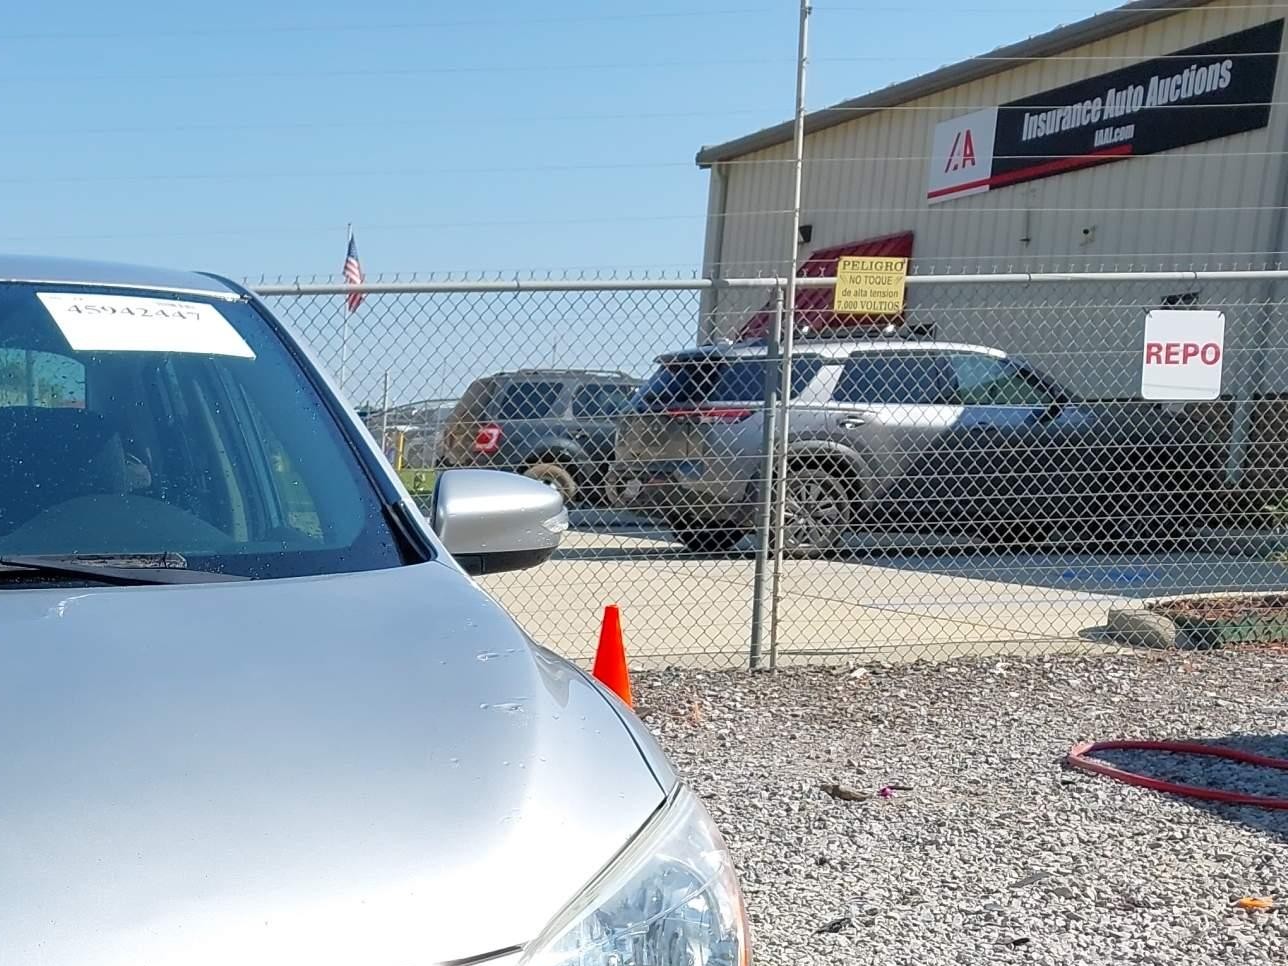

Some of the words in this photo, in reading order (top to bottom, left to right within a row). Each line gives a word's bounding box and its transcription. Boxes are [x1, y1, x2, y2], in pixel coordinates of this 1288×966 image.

[1021, 96, 1102, 141] Insurance
[1103, 84, 1144, 121] Auto
[1145, 59, 1233, 108] Auctions
[842, 260, 905, 272] PELIGRO
[849, 275, 862, 285] NO
[864, 275, 893, 286] TOQUE
[841, 288, 851, 297] de
[853, 288, 868, 298] alta
[869, 288, 899, 298] tension
[860, 300, 900, 311] VOLTIOS
[67, 304, 200, 321] 45942447
[1145, 342, 1221, 366] REPO
